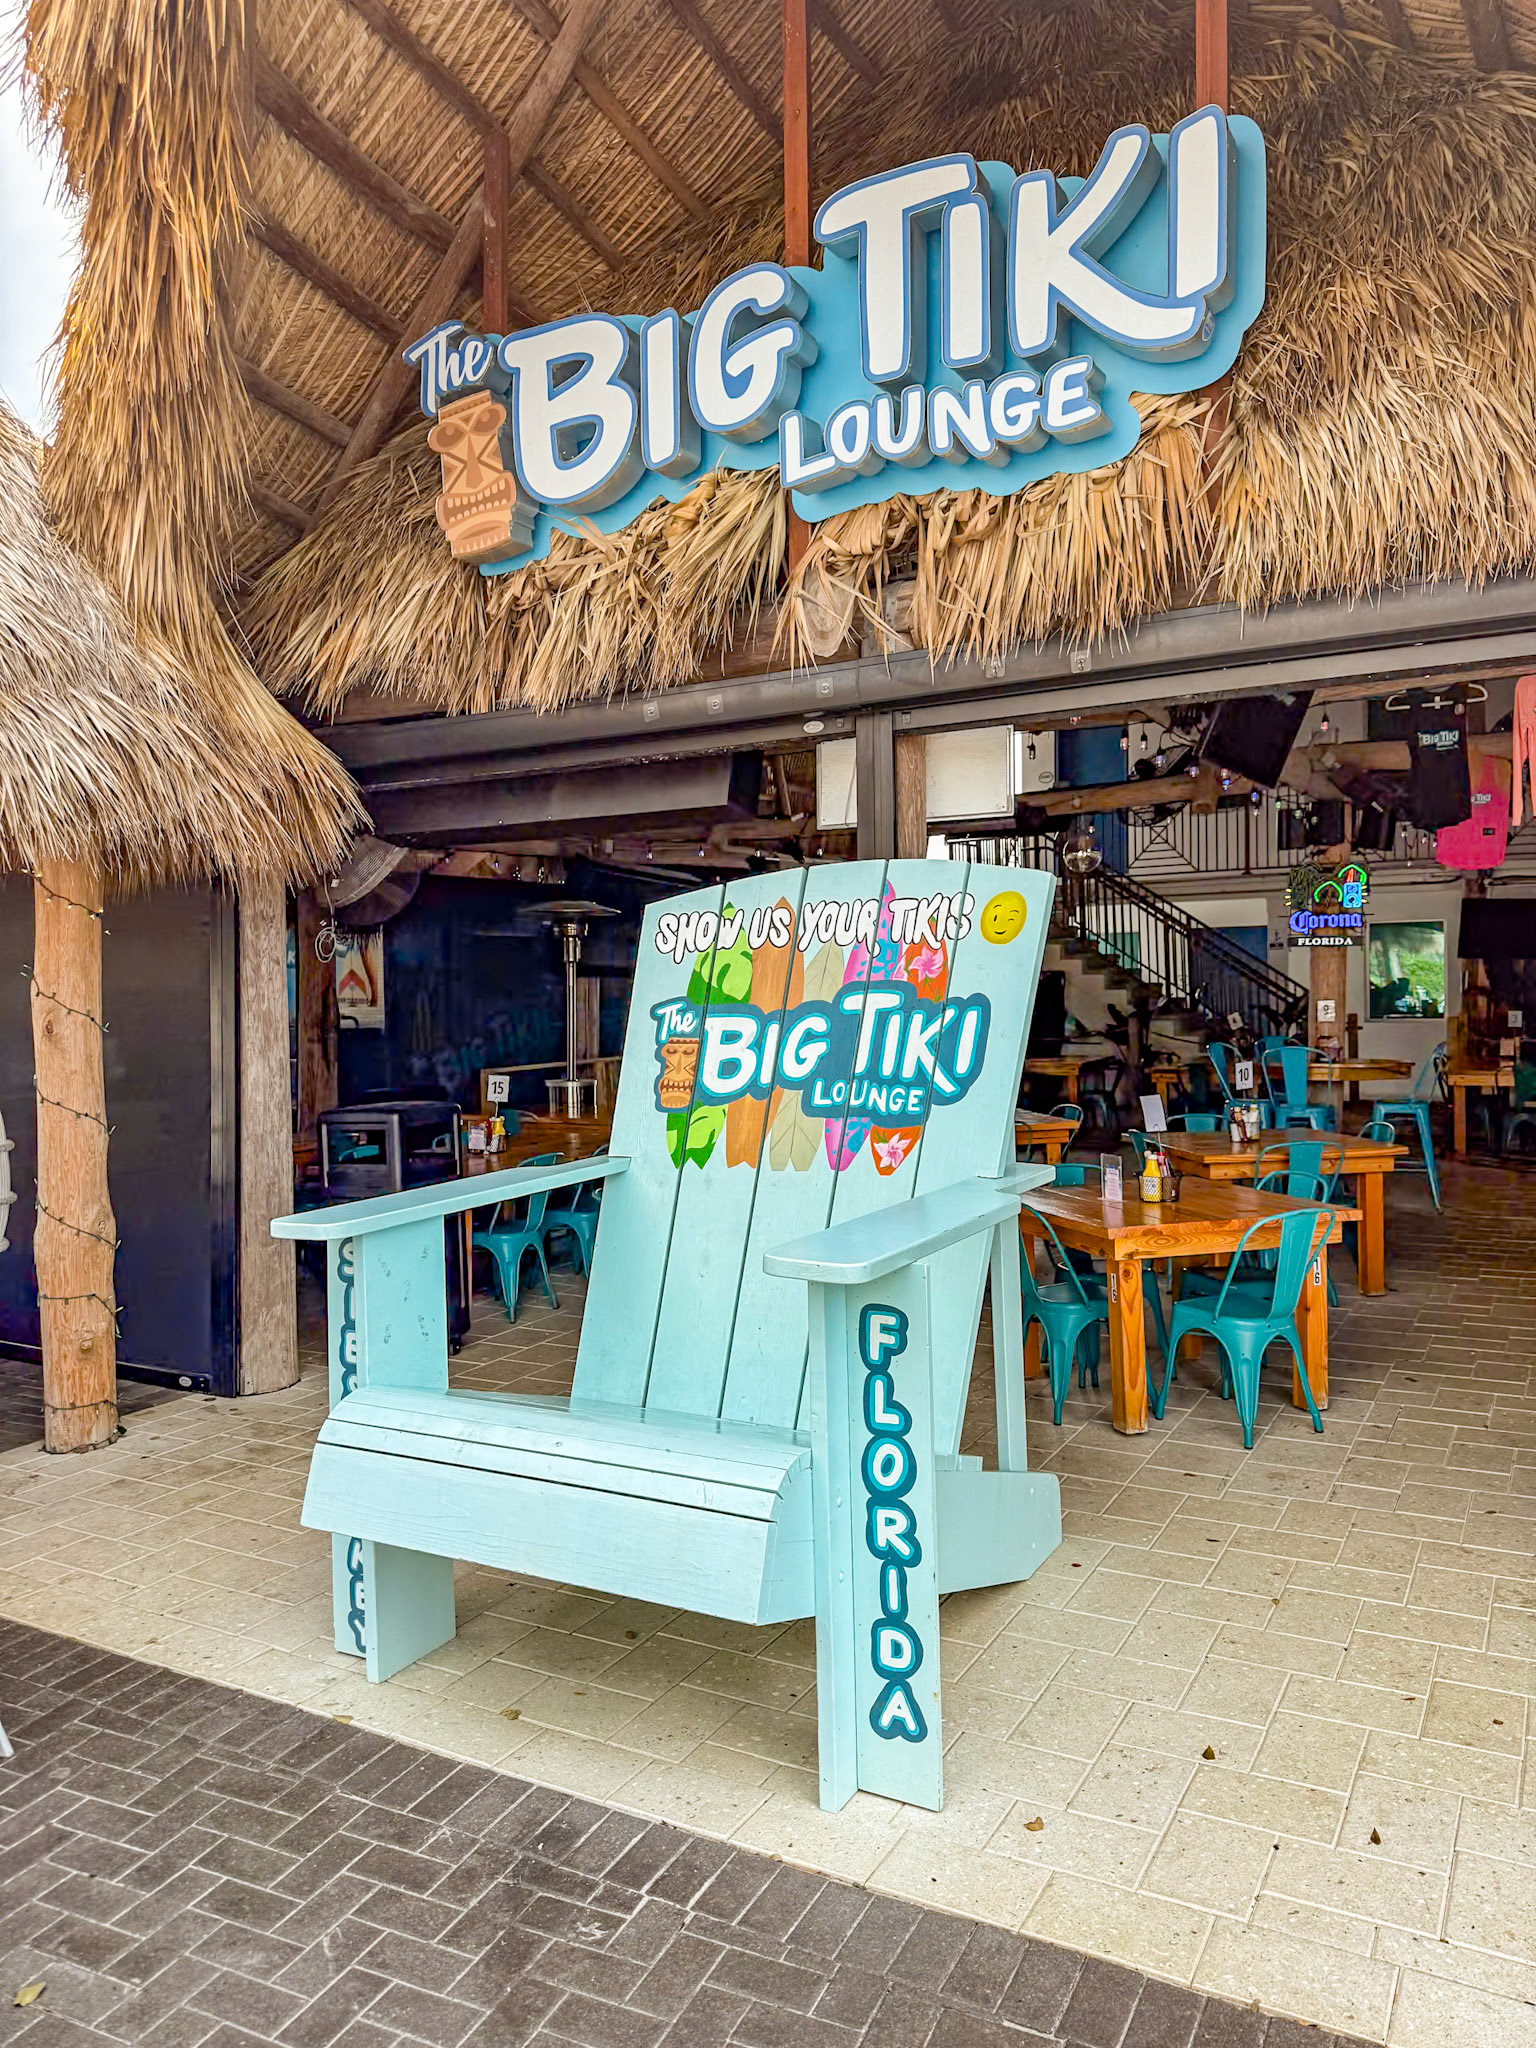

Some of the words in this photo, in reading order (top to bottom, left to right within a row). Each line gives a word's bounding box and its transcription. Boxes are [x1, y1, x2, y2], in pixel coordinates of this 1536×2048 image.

[403, 320, 494, 417] The
[497, 262, 801, 504] BIG
[815, 104, 1229, 386] TIKI
[780, 355, 1101, 491] LOUNGE
[655, 909, 744, 965] SHOW
[747, 906, 792, 949] US
[796, 899, 880, 958] YOUR
[888, 892, 974, 950] TIKIS
[1288, 909, 1363, 935] Corona
[1297, 937, 1354, 946] FLORIDA
[655, 1000, 698, 1043] The
[699, 1014, 831, 1098] BIG
[840, 989, 983, 1097] TIKI
[491, 1081, 504, 1095] 15
[811, 1079, 926, 1115] LOUNGE
[1238, 1067, 1249, 1082] 10
[862, 1307, 925, 1740] FLORIDA
